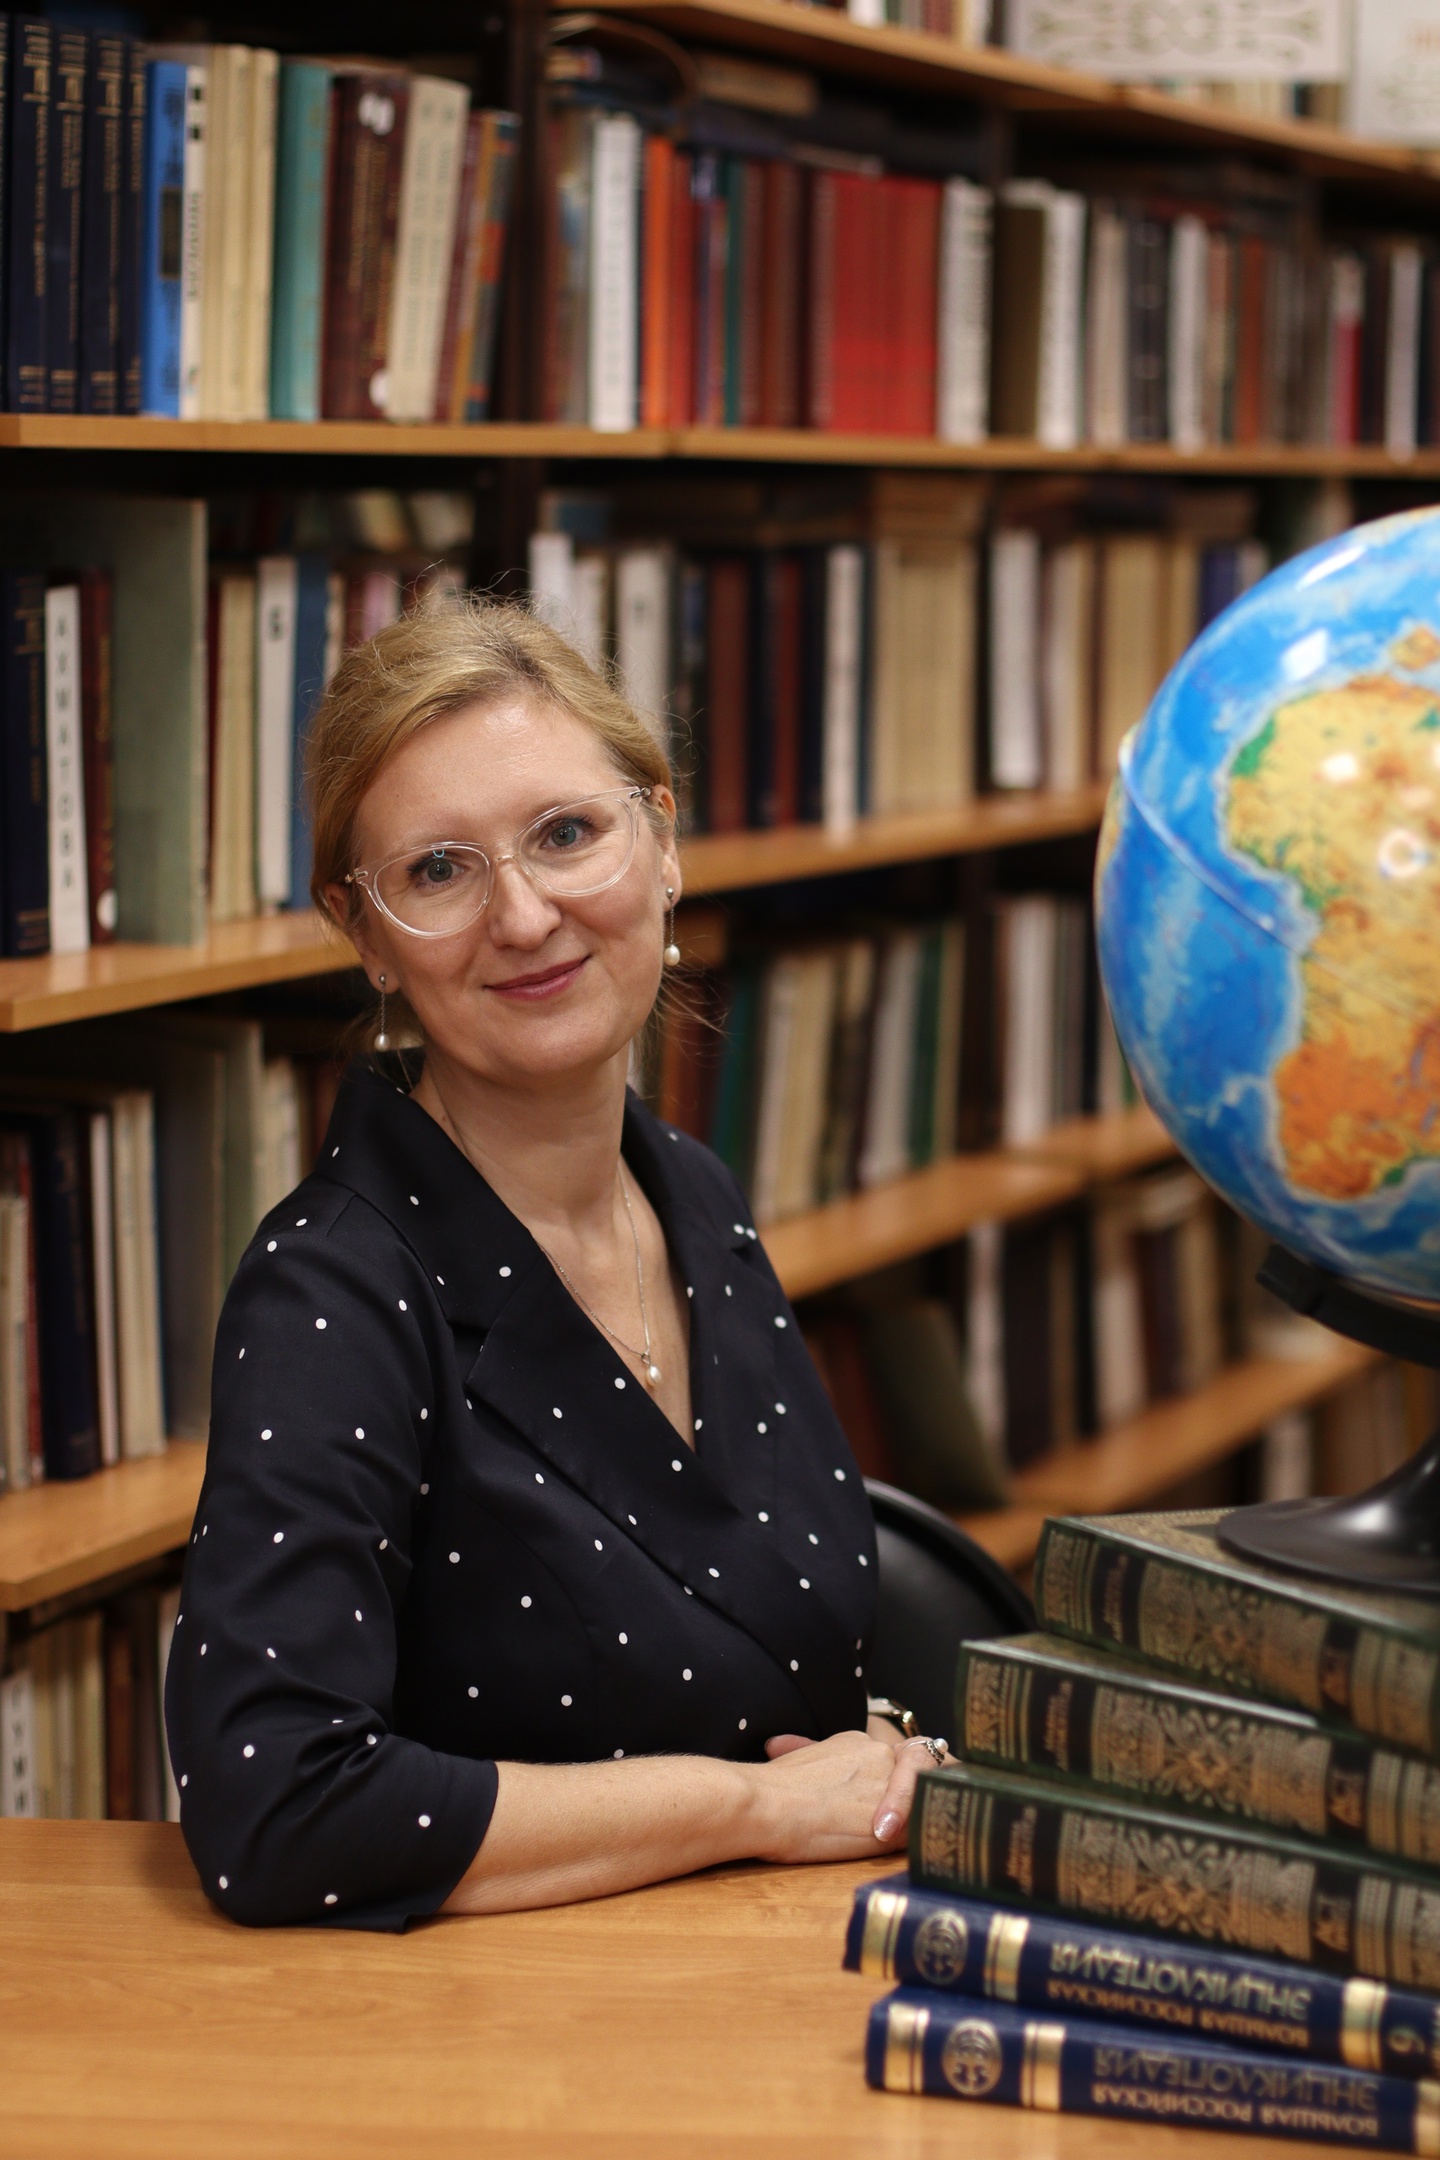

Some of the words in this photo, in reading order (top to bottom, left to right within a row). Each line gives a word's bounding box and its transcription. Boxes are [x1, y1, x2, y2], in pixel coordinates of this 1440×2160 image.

[54, 613, 76, 893] АХМАТОВА
[1046, 1979, 1194, 2026] РОССИЙСКАЯ
[1049, 1942, 1312, 2022] ЭНЦИКЛОПЕДИЯ
[1200, 2009, 1310, 2049] БОЛЬШАЯ
[1092, 2081, 1253, 2123] РОССИЙСКАЯ
[1094, 2048, 1380, 2111] ЭНЦИКЛОПЕДИЯ
[1260, 2104, 1379, 2138] БОЛЬШАЯ
